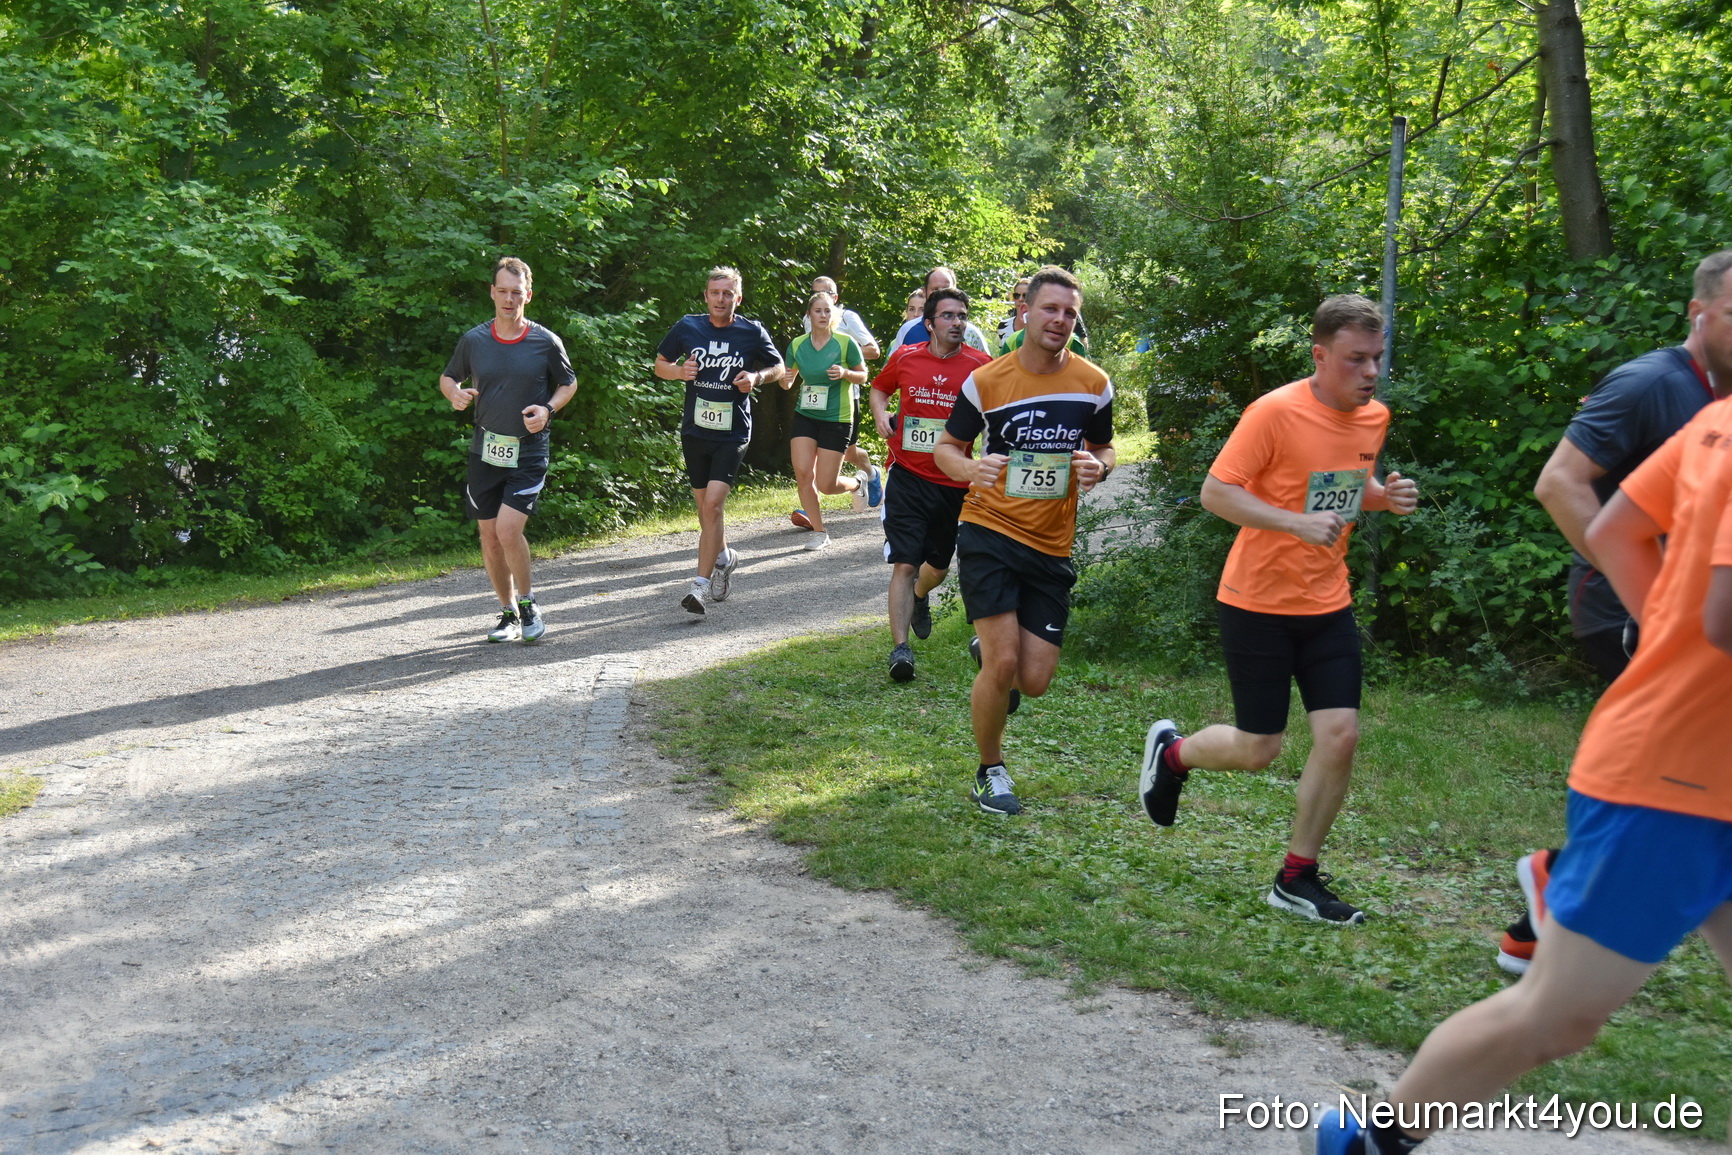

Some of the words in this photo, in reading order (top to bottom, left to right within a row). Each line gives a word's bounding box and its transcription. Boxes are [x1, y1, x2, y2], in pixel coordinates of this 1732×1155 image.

[691, 347, 744, 381] Burgis
[807, 394, 818, 403] 13
[908, 386, 931, 398] Echtes
[915, 398, 935, 406] IMMER
[936, 401, 956, 409] FRISC
[701, 410, 723, 422] 401
[911, 429, 935, 444] 601
[1015, 424, 1083, 442] Fischer
[486, 442, 514, 459] 1485
[1021, 468, 1057, 487] 755
[1312, 488, 1359, 512] 2297
